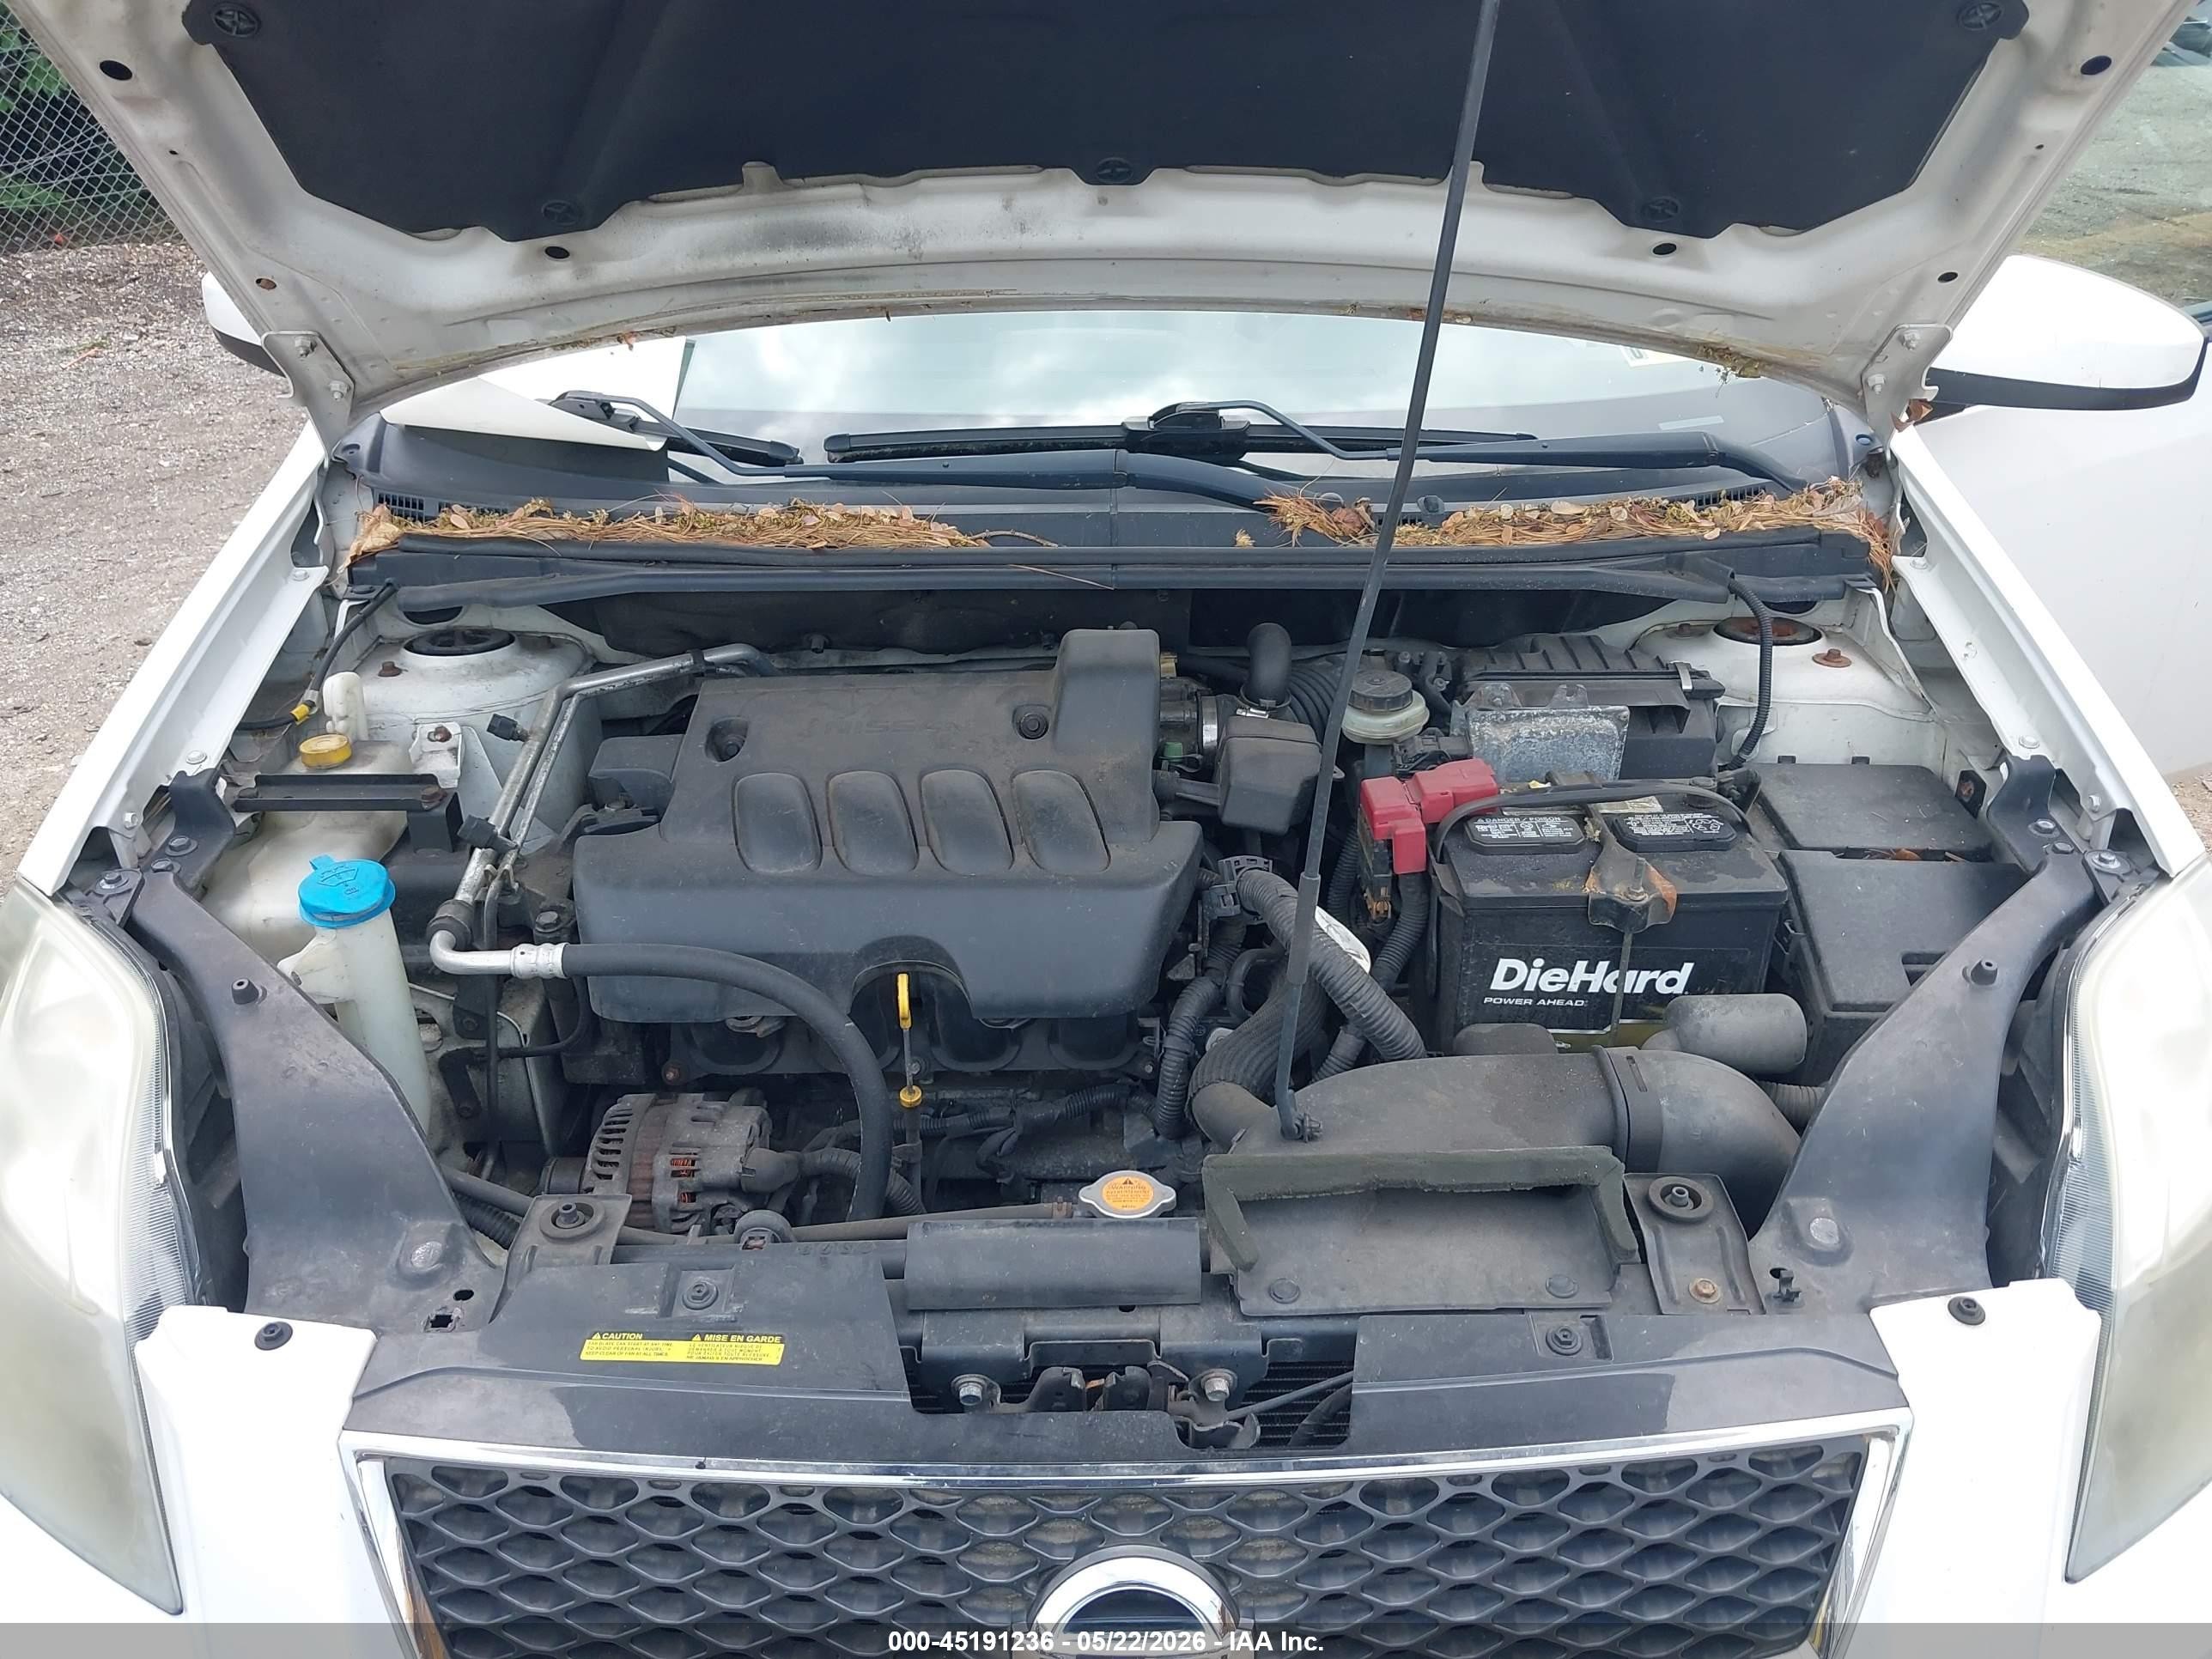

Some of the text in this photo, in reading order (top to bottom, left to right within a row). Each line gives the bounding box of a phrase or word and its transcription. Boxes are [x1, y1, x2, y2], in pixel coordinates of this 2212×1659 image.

[1490, 957, 1695, 994] DieHard
[1484, 997, 1584, 1006] POWER AHEAD
